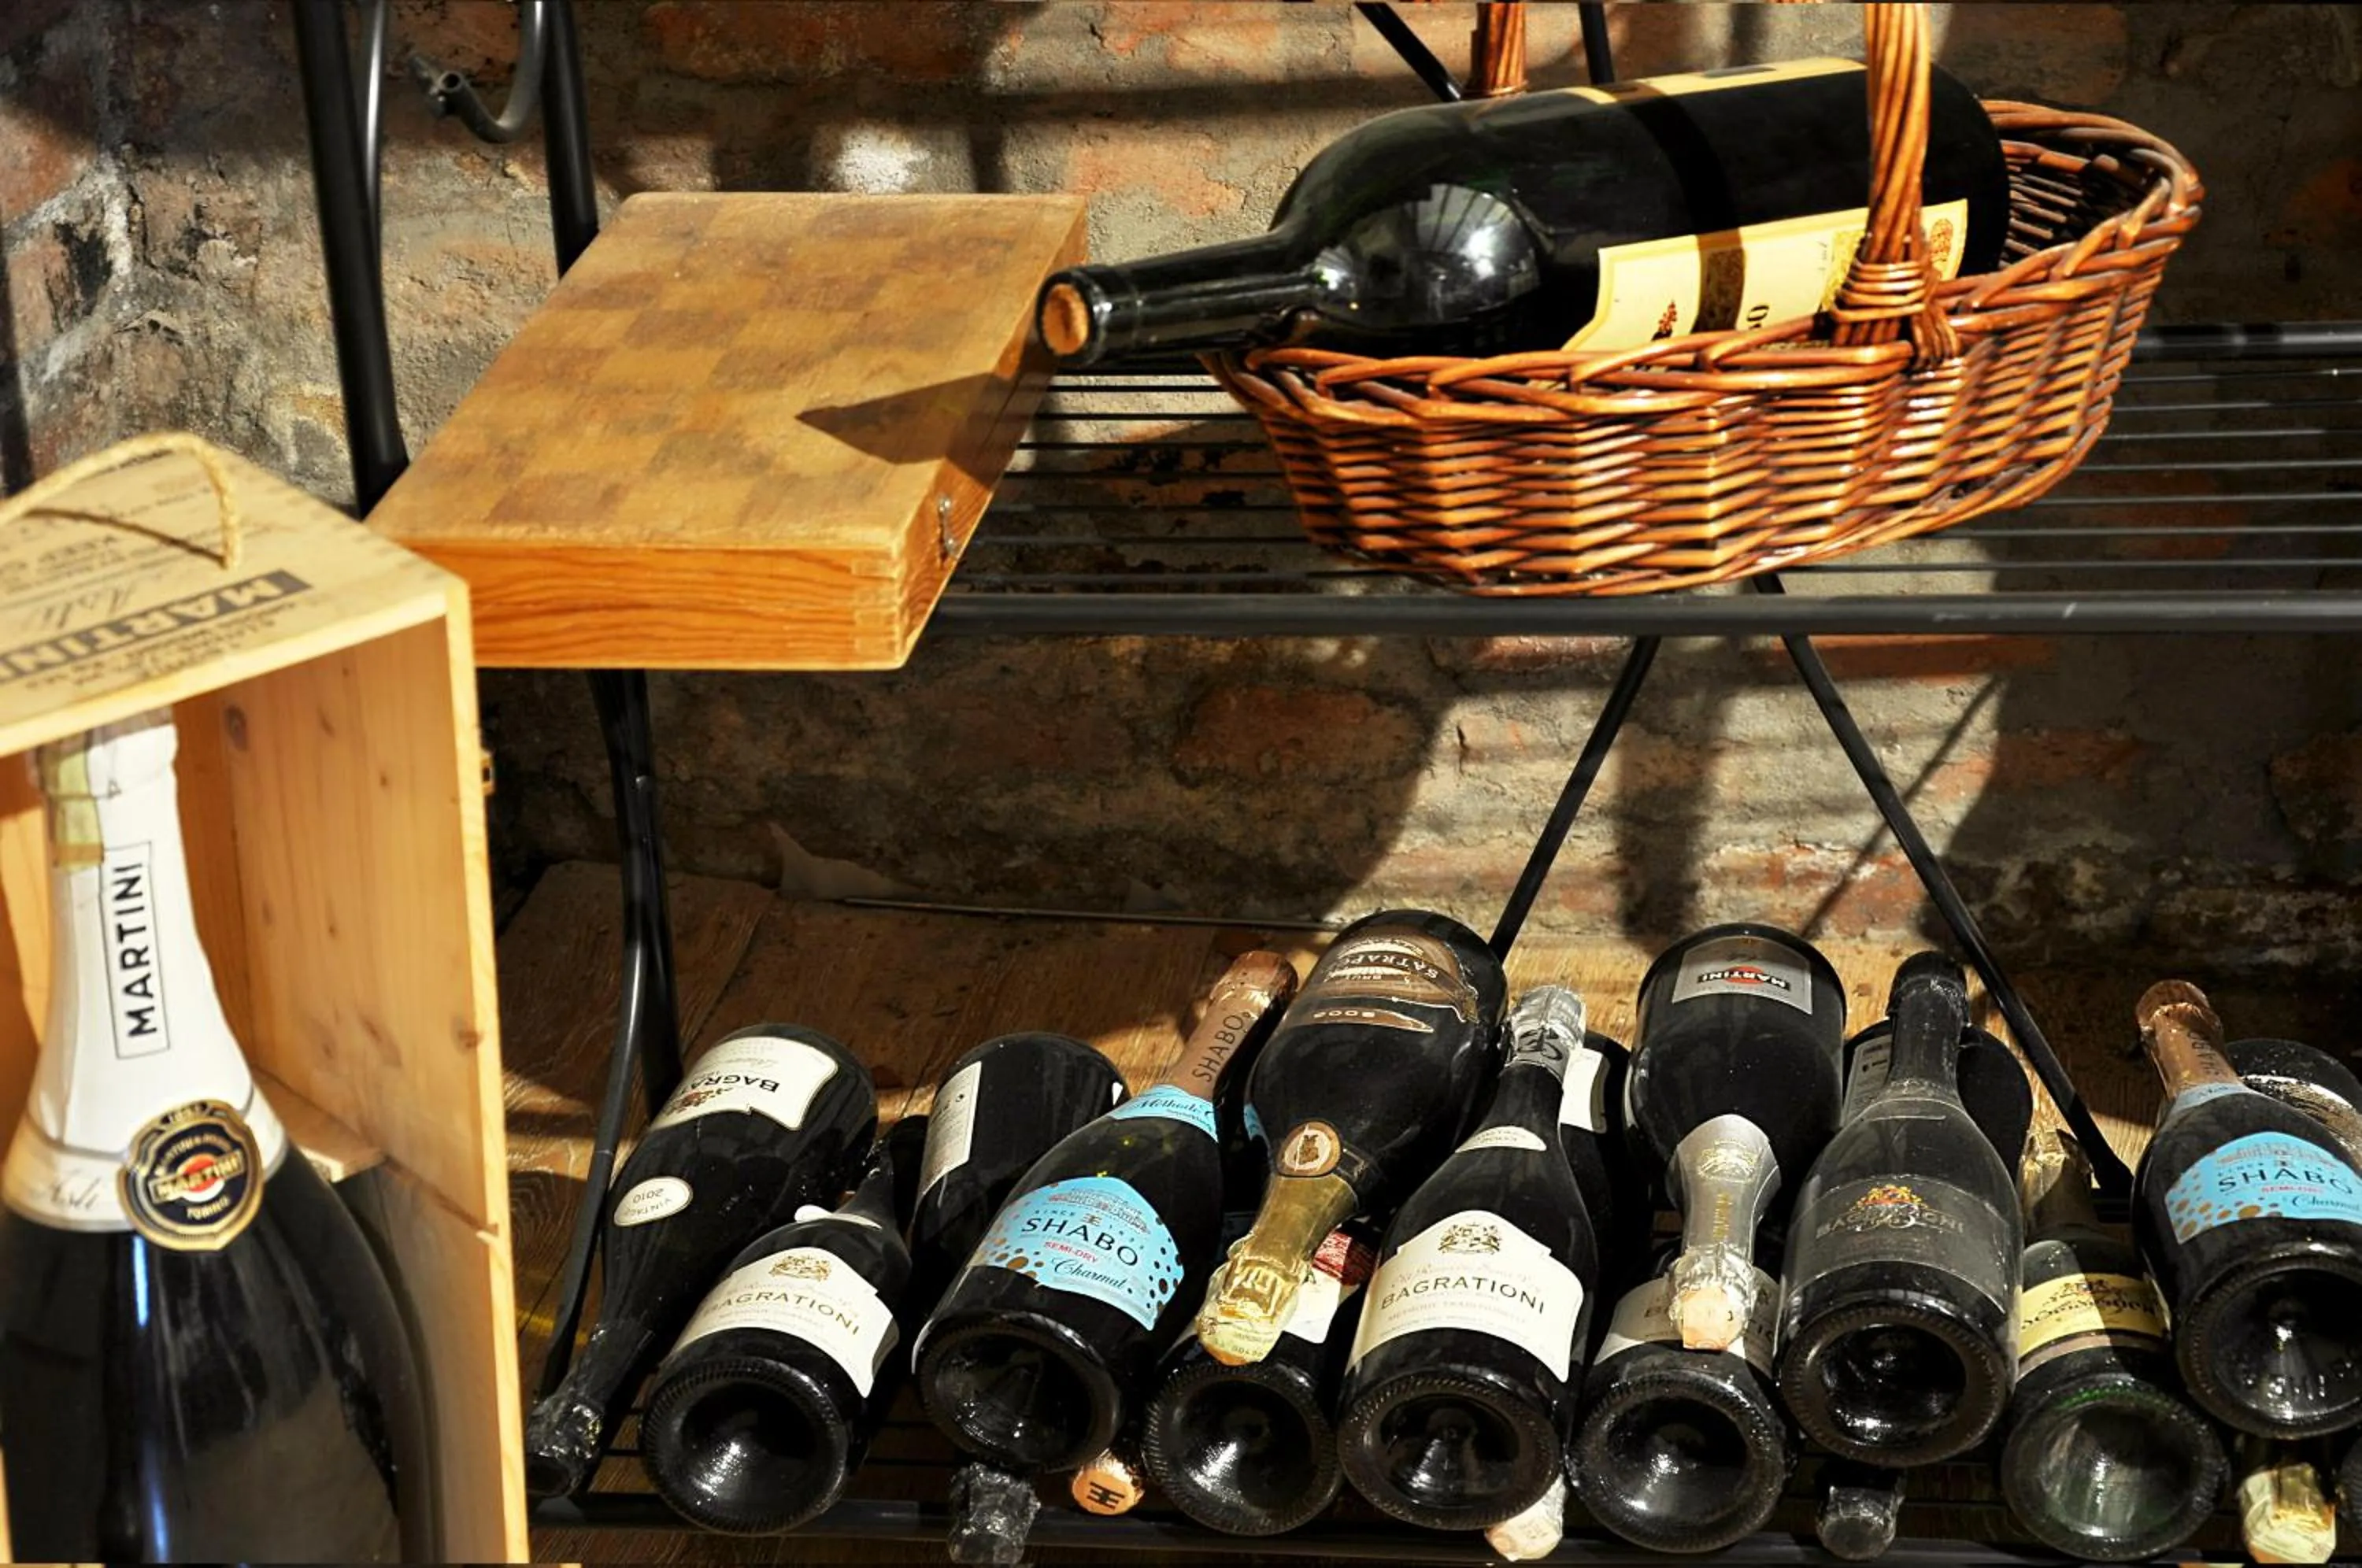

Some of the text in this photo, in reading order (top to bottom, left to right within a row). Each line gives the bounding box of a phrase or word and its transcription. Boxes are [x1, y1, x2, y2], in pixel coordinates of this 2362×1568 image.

[114, 862, 158, 1039] MARTINI
[1701, 971, 1787, 990] MARTINI
[1191, 1014, 1243, 1083] SHABO
[2218, 1168, 2353, 1195] SHABO
[1021, 1218, 1138, 1267] SHABO
[1053, 1259, 1128, 1289] Charmat
[1381, 1275, 1544, 1315] BAGRATIONI
